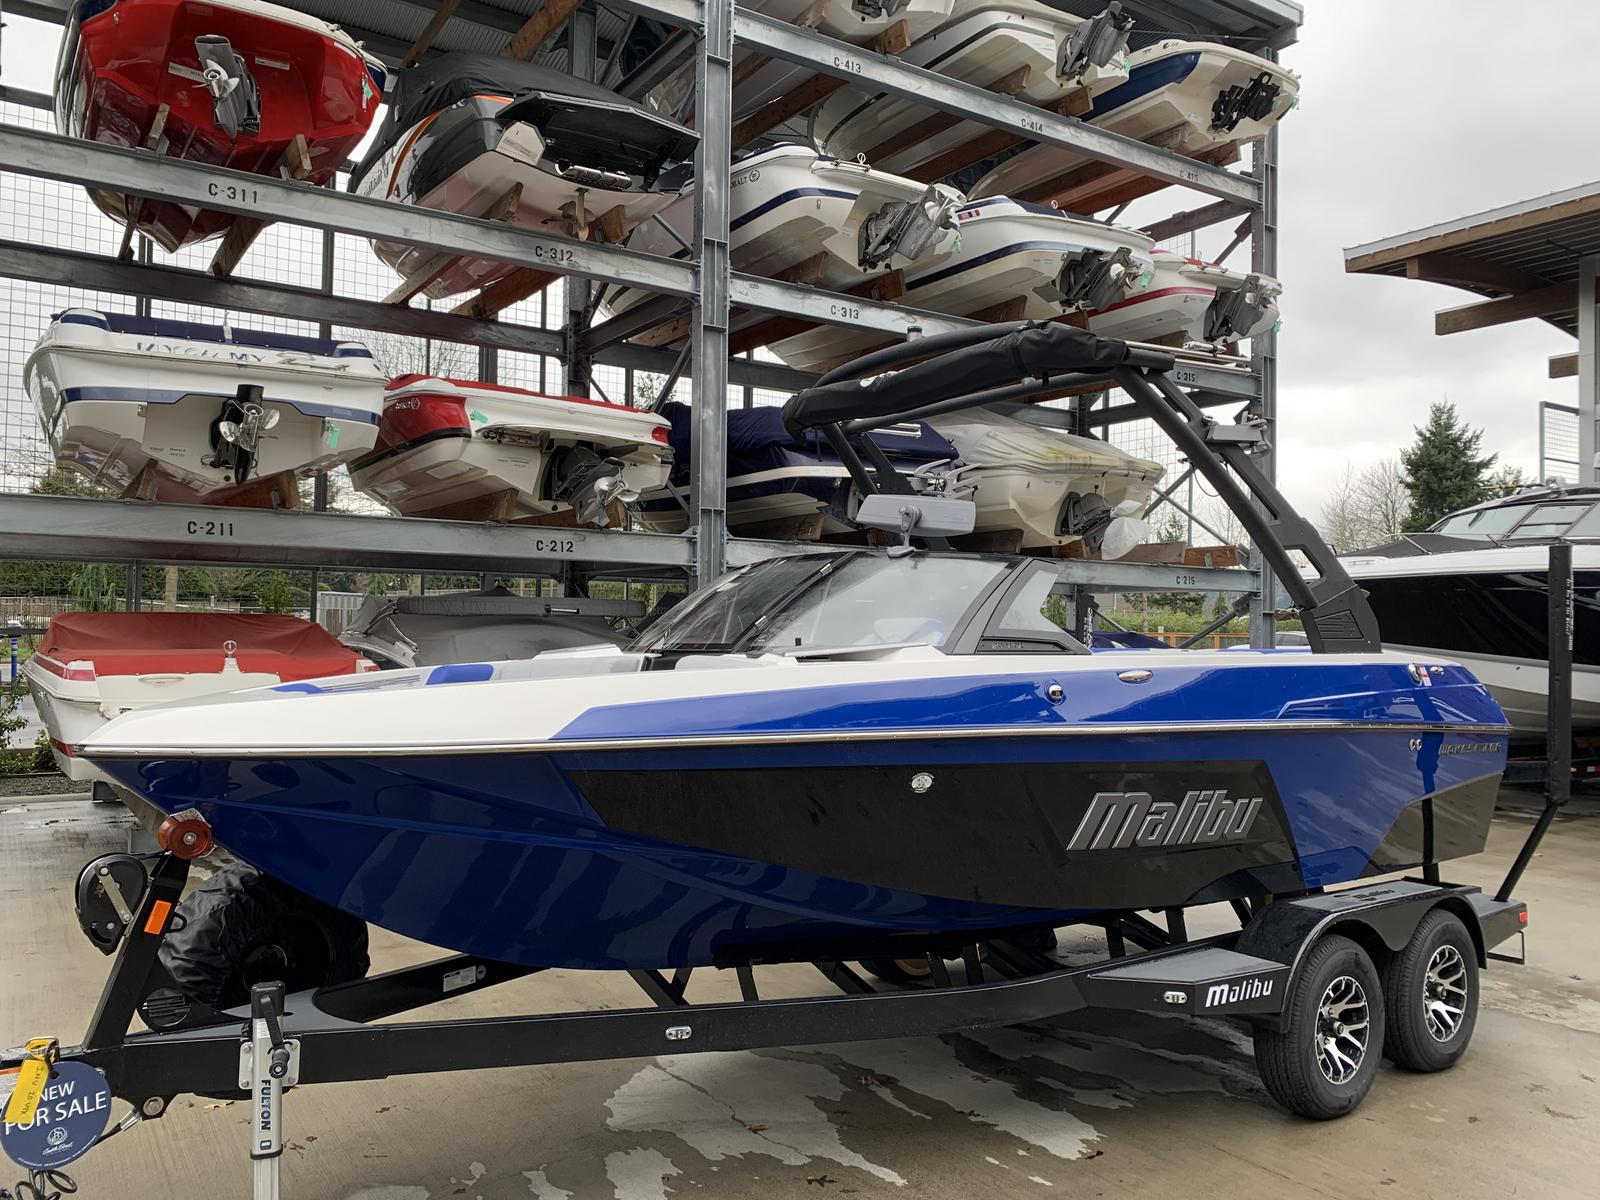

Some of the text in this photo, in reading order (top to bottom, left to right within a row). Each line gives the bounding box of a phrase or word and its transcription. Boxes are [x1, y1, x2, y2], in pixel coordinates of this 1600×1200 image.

[834, 56, 861, 73] C-413
[1021, 118, 1043, 132] C-414
[208, 182, 258, 204] C-311
[535, 245, 573, 262] C-312
[830, 304, 859, 320] C-313
[1176, 371, 1196, 383] C-315
[187, 520, 233, 537] C-211
[536, 539, 574, 553] C-212
[1175, 575, 1195, 585] C-215
[1065, 789, 1264, 851] Malibu
[1204, 978, 1274, 1009] Malibu
[40, 1080, 75, 1102] NEW
[55, 1091, 107, 1122] SALE
[260, 1079, 272, 1131] FULTON
